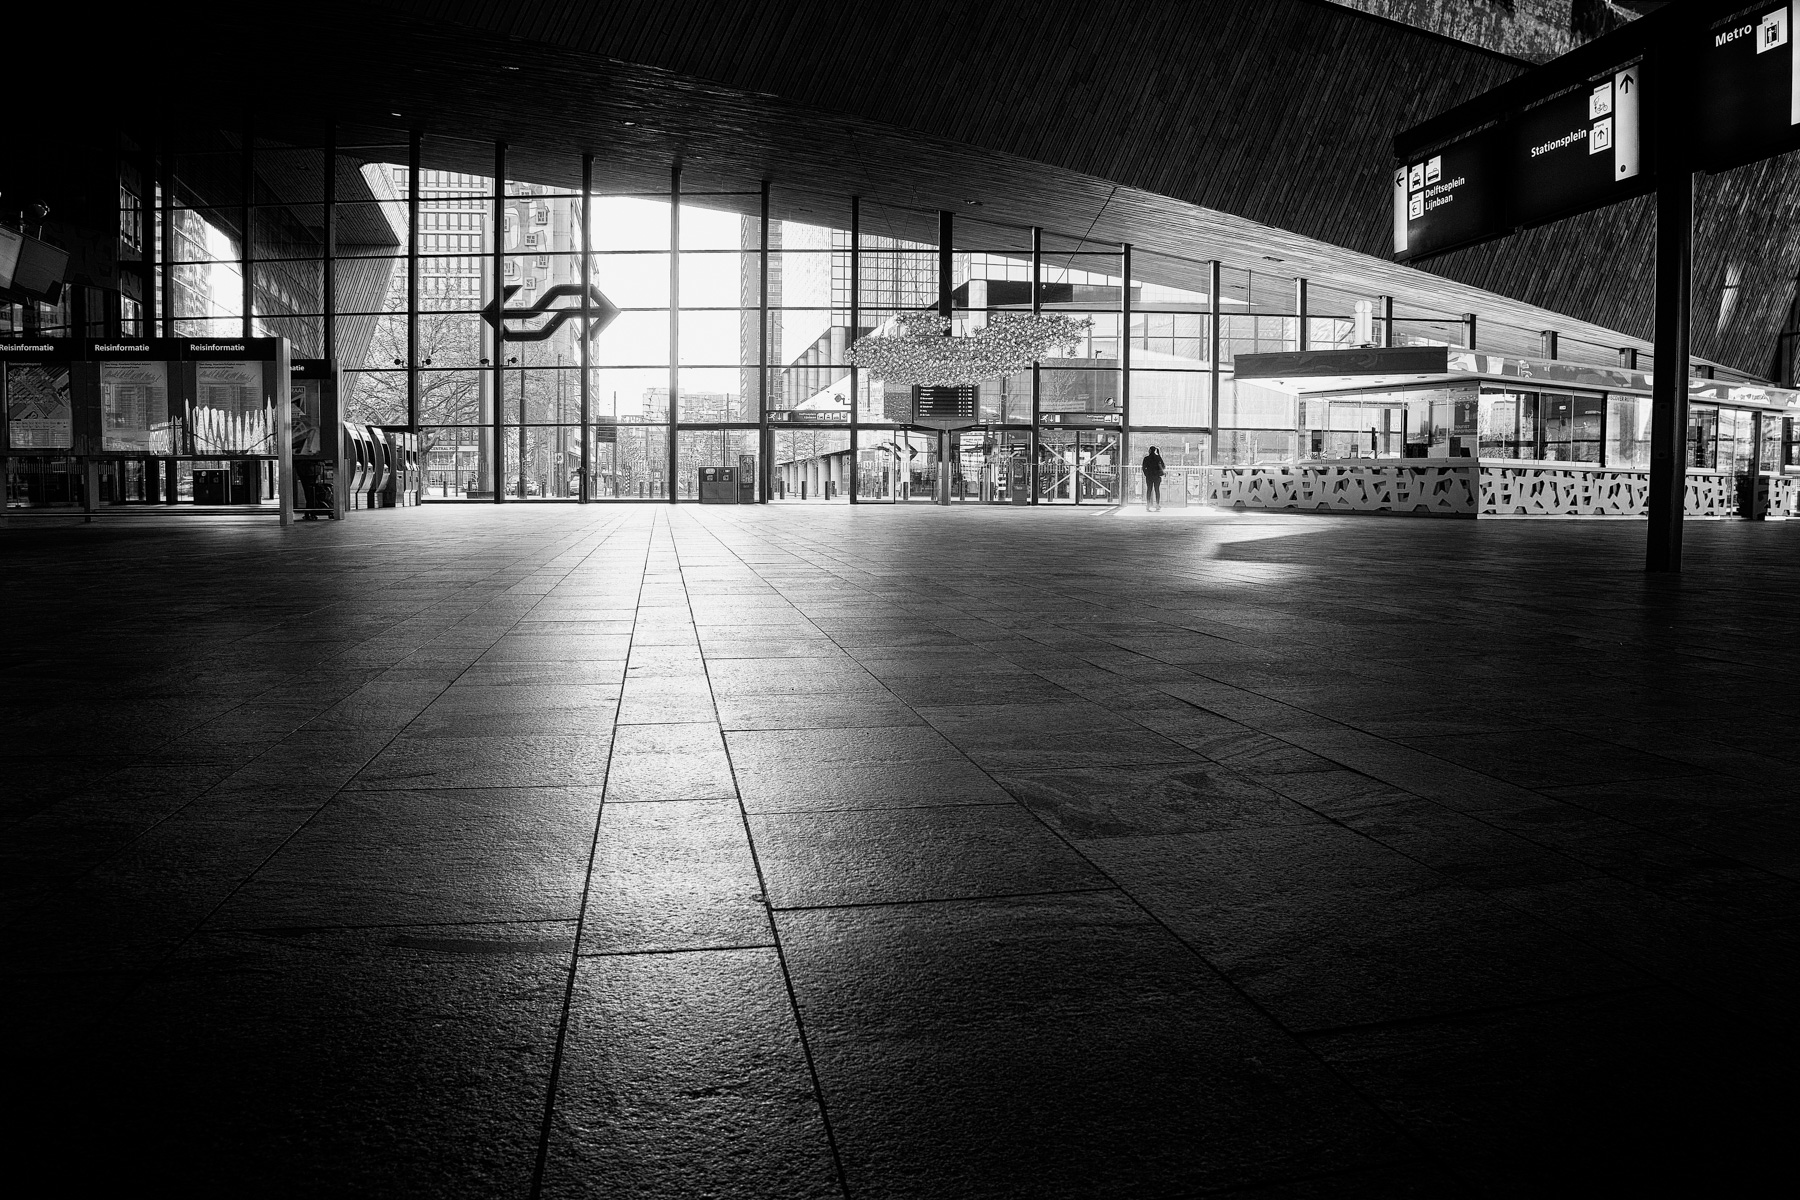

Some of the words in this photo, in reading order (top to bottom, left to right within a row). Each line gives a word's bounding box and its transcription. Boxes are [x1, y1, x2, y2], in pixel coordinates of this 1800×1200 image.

[1715, 24, 1752, 48] Metro
[1530, 128, 1588, 158] Stationsplein
[1425, 176, 1466, 199] Delftseplein
[1425, 194, 1454, 211] Lijnbaan
[0, 343, 54, 352] Reisinformatie
[94, 343, 150, 352] Reisinformatie
[190, 343, 245, 352] Reisinformatie
